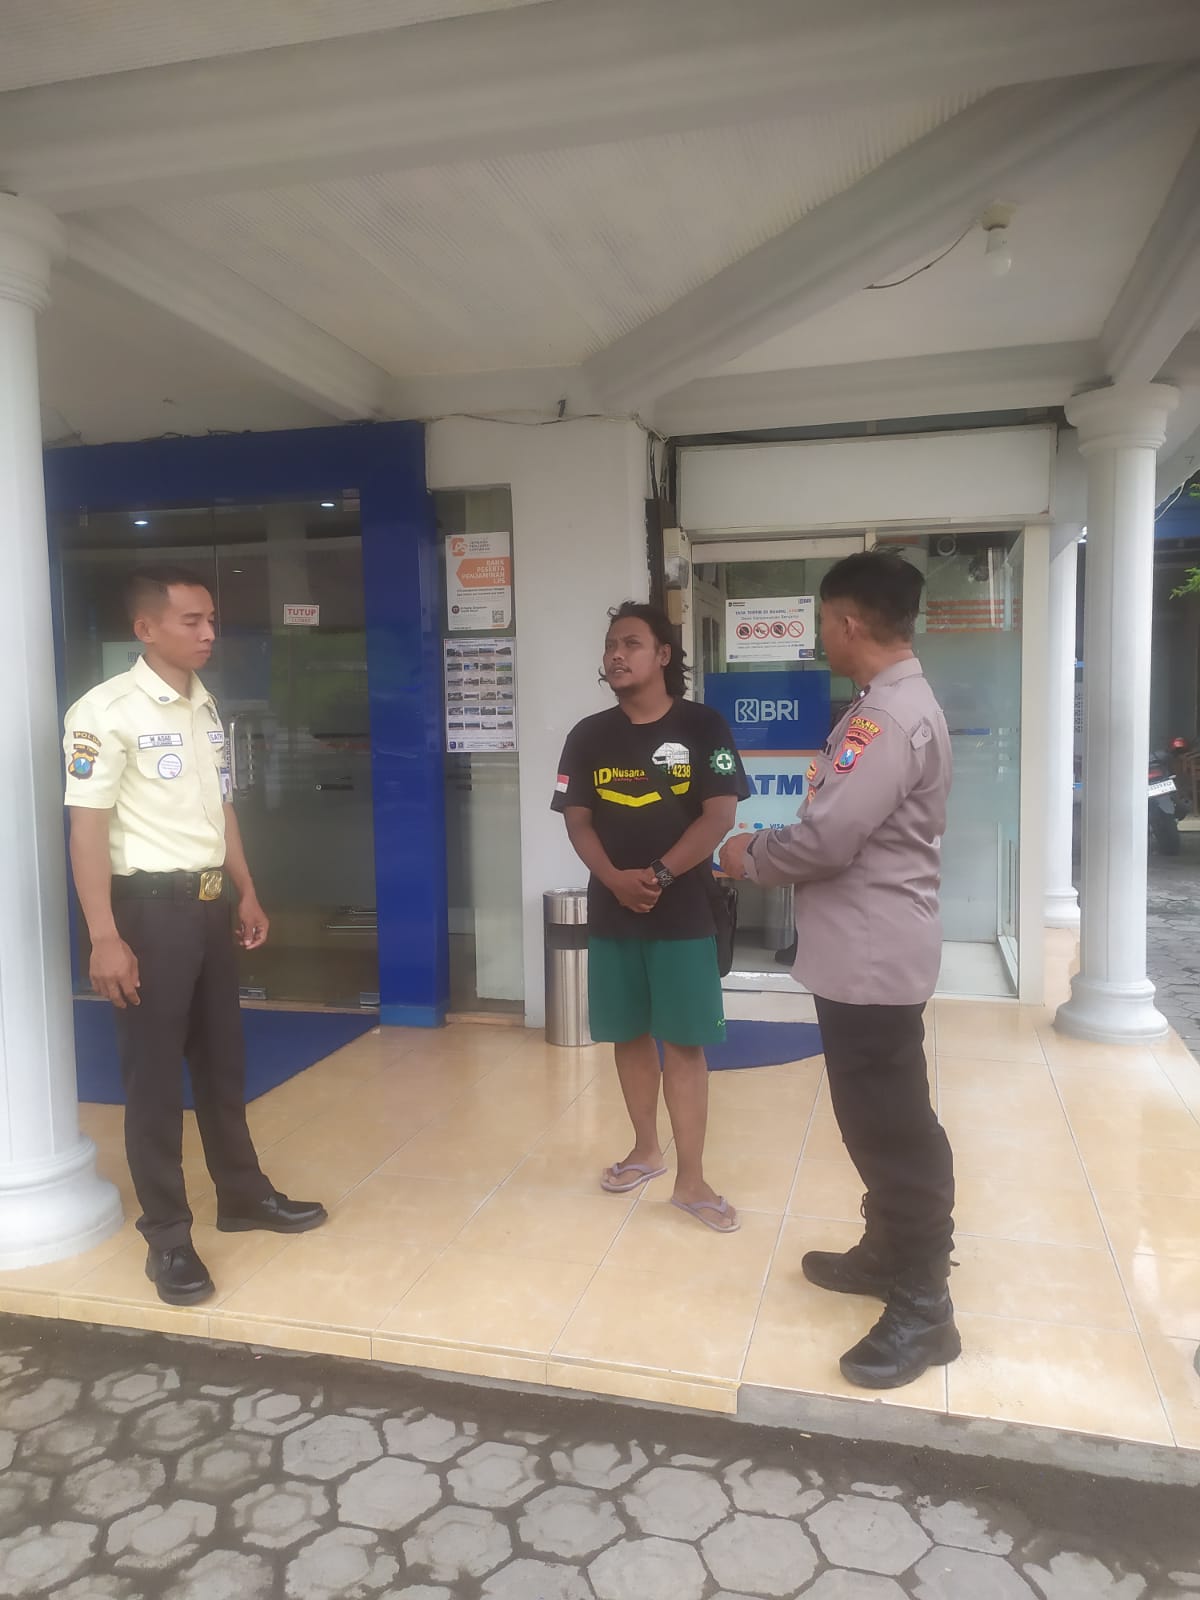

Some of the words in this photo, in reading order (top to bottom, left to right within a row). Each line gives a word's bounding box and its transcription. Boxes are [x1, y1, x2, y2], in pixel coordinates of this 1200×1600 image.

[287, 608, 317, 616] TUTUP
[760, 699, 799, 721] BRI
[672, 764, 691, 778] 4238
